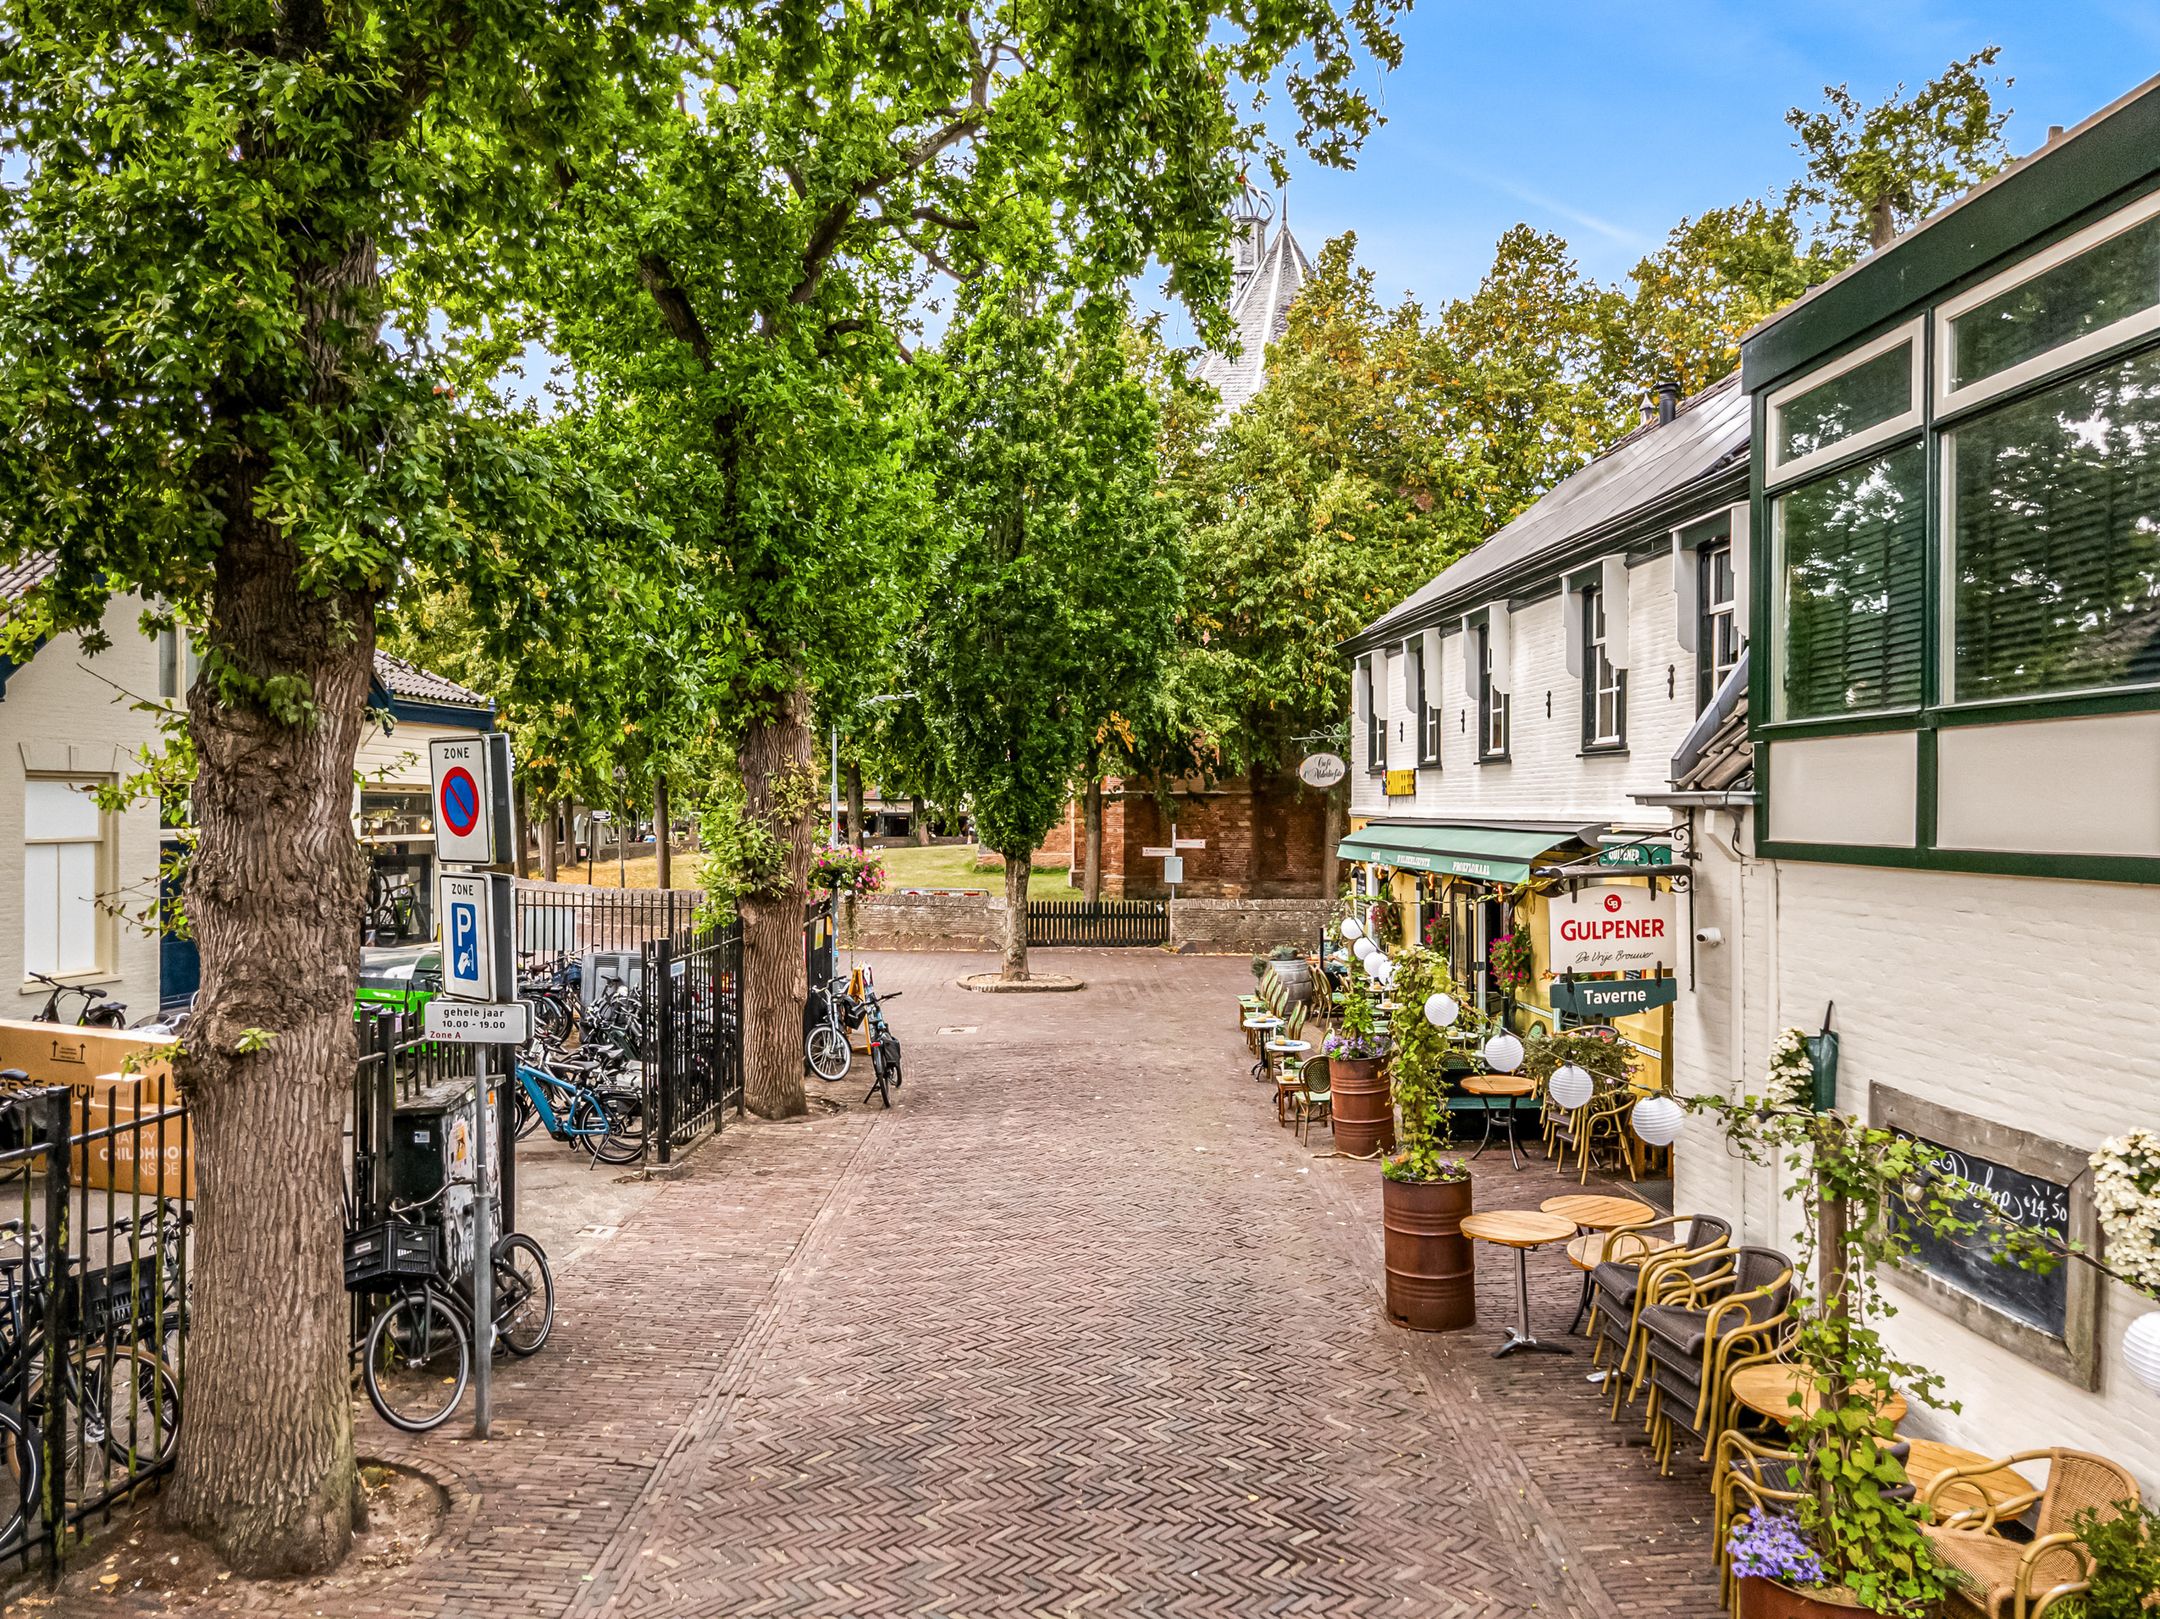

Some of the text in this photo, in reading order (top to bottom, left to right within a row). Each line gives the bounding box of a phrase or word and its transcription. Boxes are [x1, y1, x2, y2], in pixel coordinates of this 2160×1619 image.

[444, 747, 470, 759] ZONE
[451, 883, 474, 896] ZONE
[1560, 918, 1665, 942] GULPENER
[1575, 950, 1654, 966] De Vrije Brouwer
[1584, 989, 1647, 1005] Taverne
[443, 1008, 504, 1019] gehele jaar
[442, 1020, 469, 1028] 10.00
[480, 1021, 506, 1029] 19.00
[430, 1031, 461, 1039] Zone A
[138, 1162, 180, 1176] NSDE
